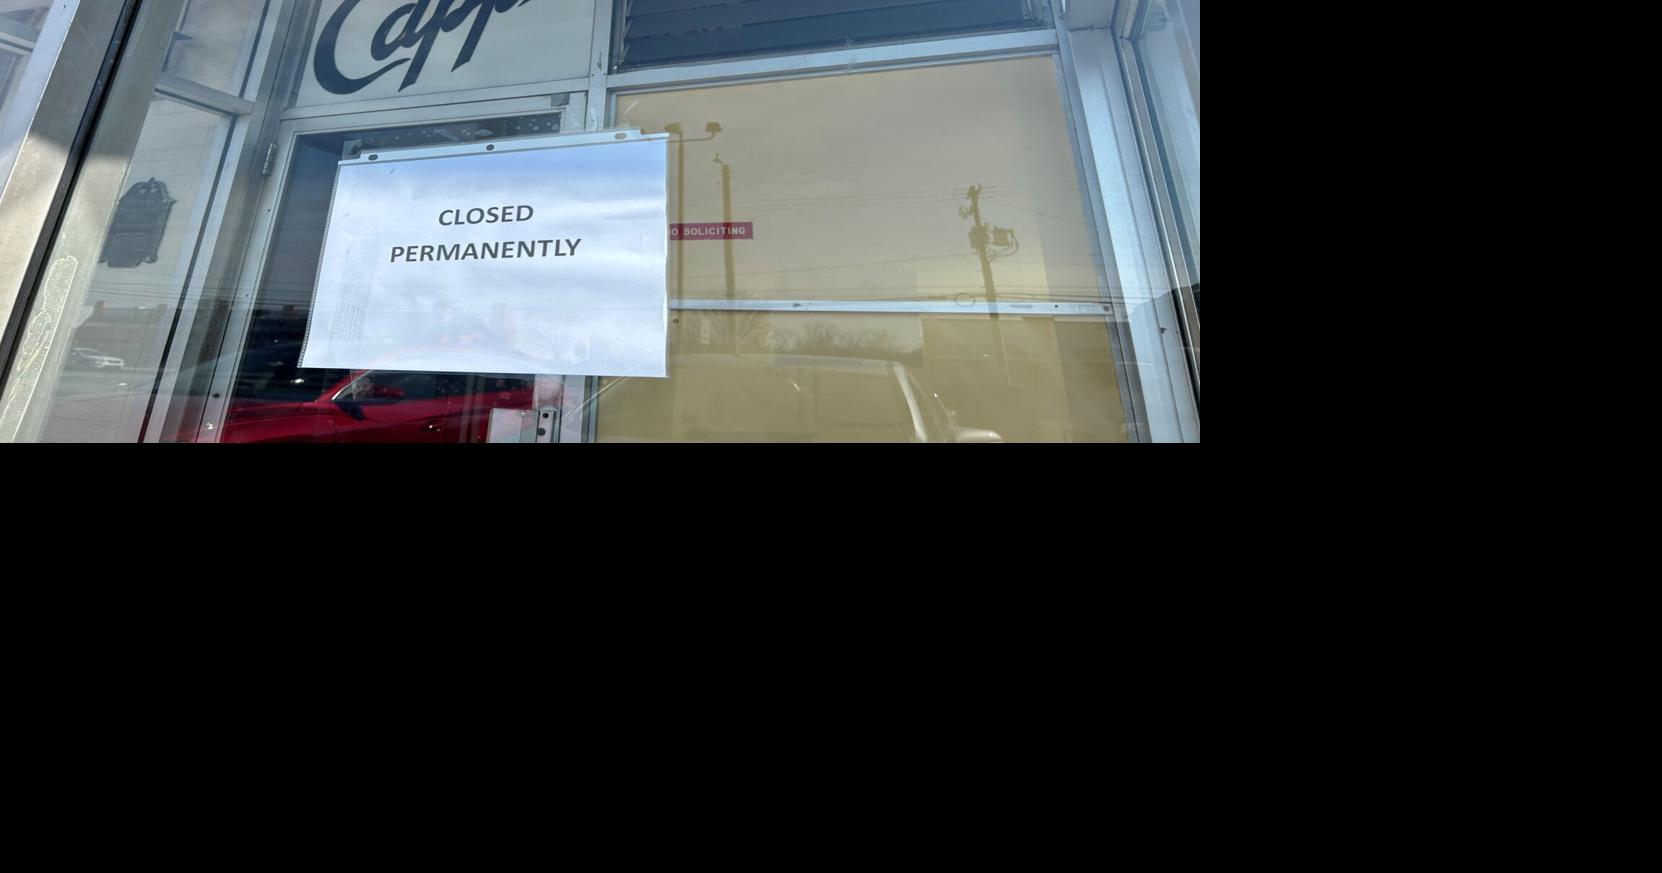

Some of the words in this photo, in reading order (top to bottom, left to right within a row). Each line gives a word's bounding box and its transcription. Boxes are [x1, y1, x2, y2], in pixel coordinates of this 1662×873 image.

[437, 204, 535, 227] CLOSED
[683, 226, 747, 237] SOLICITING
[389, 237, 583, 263] PERMANENTLY
